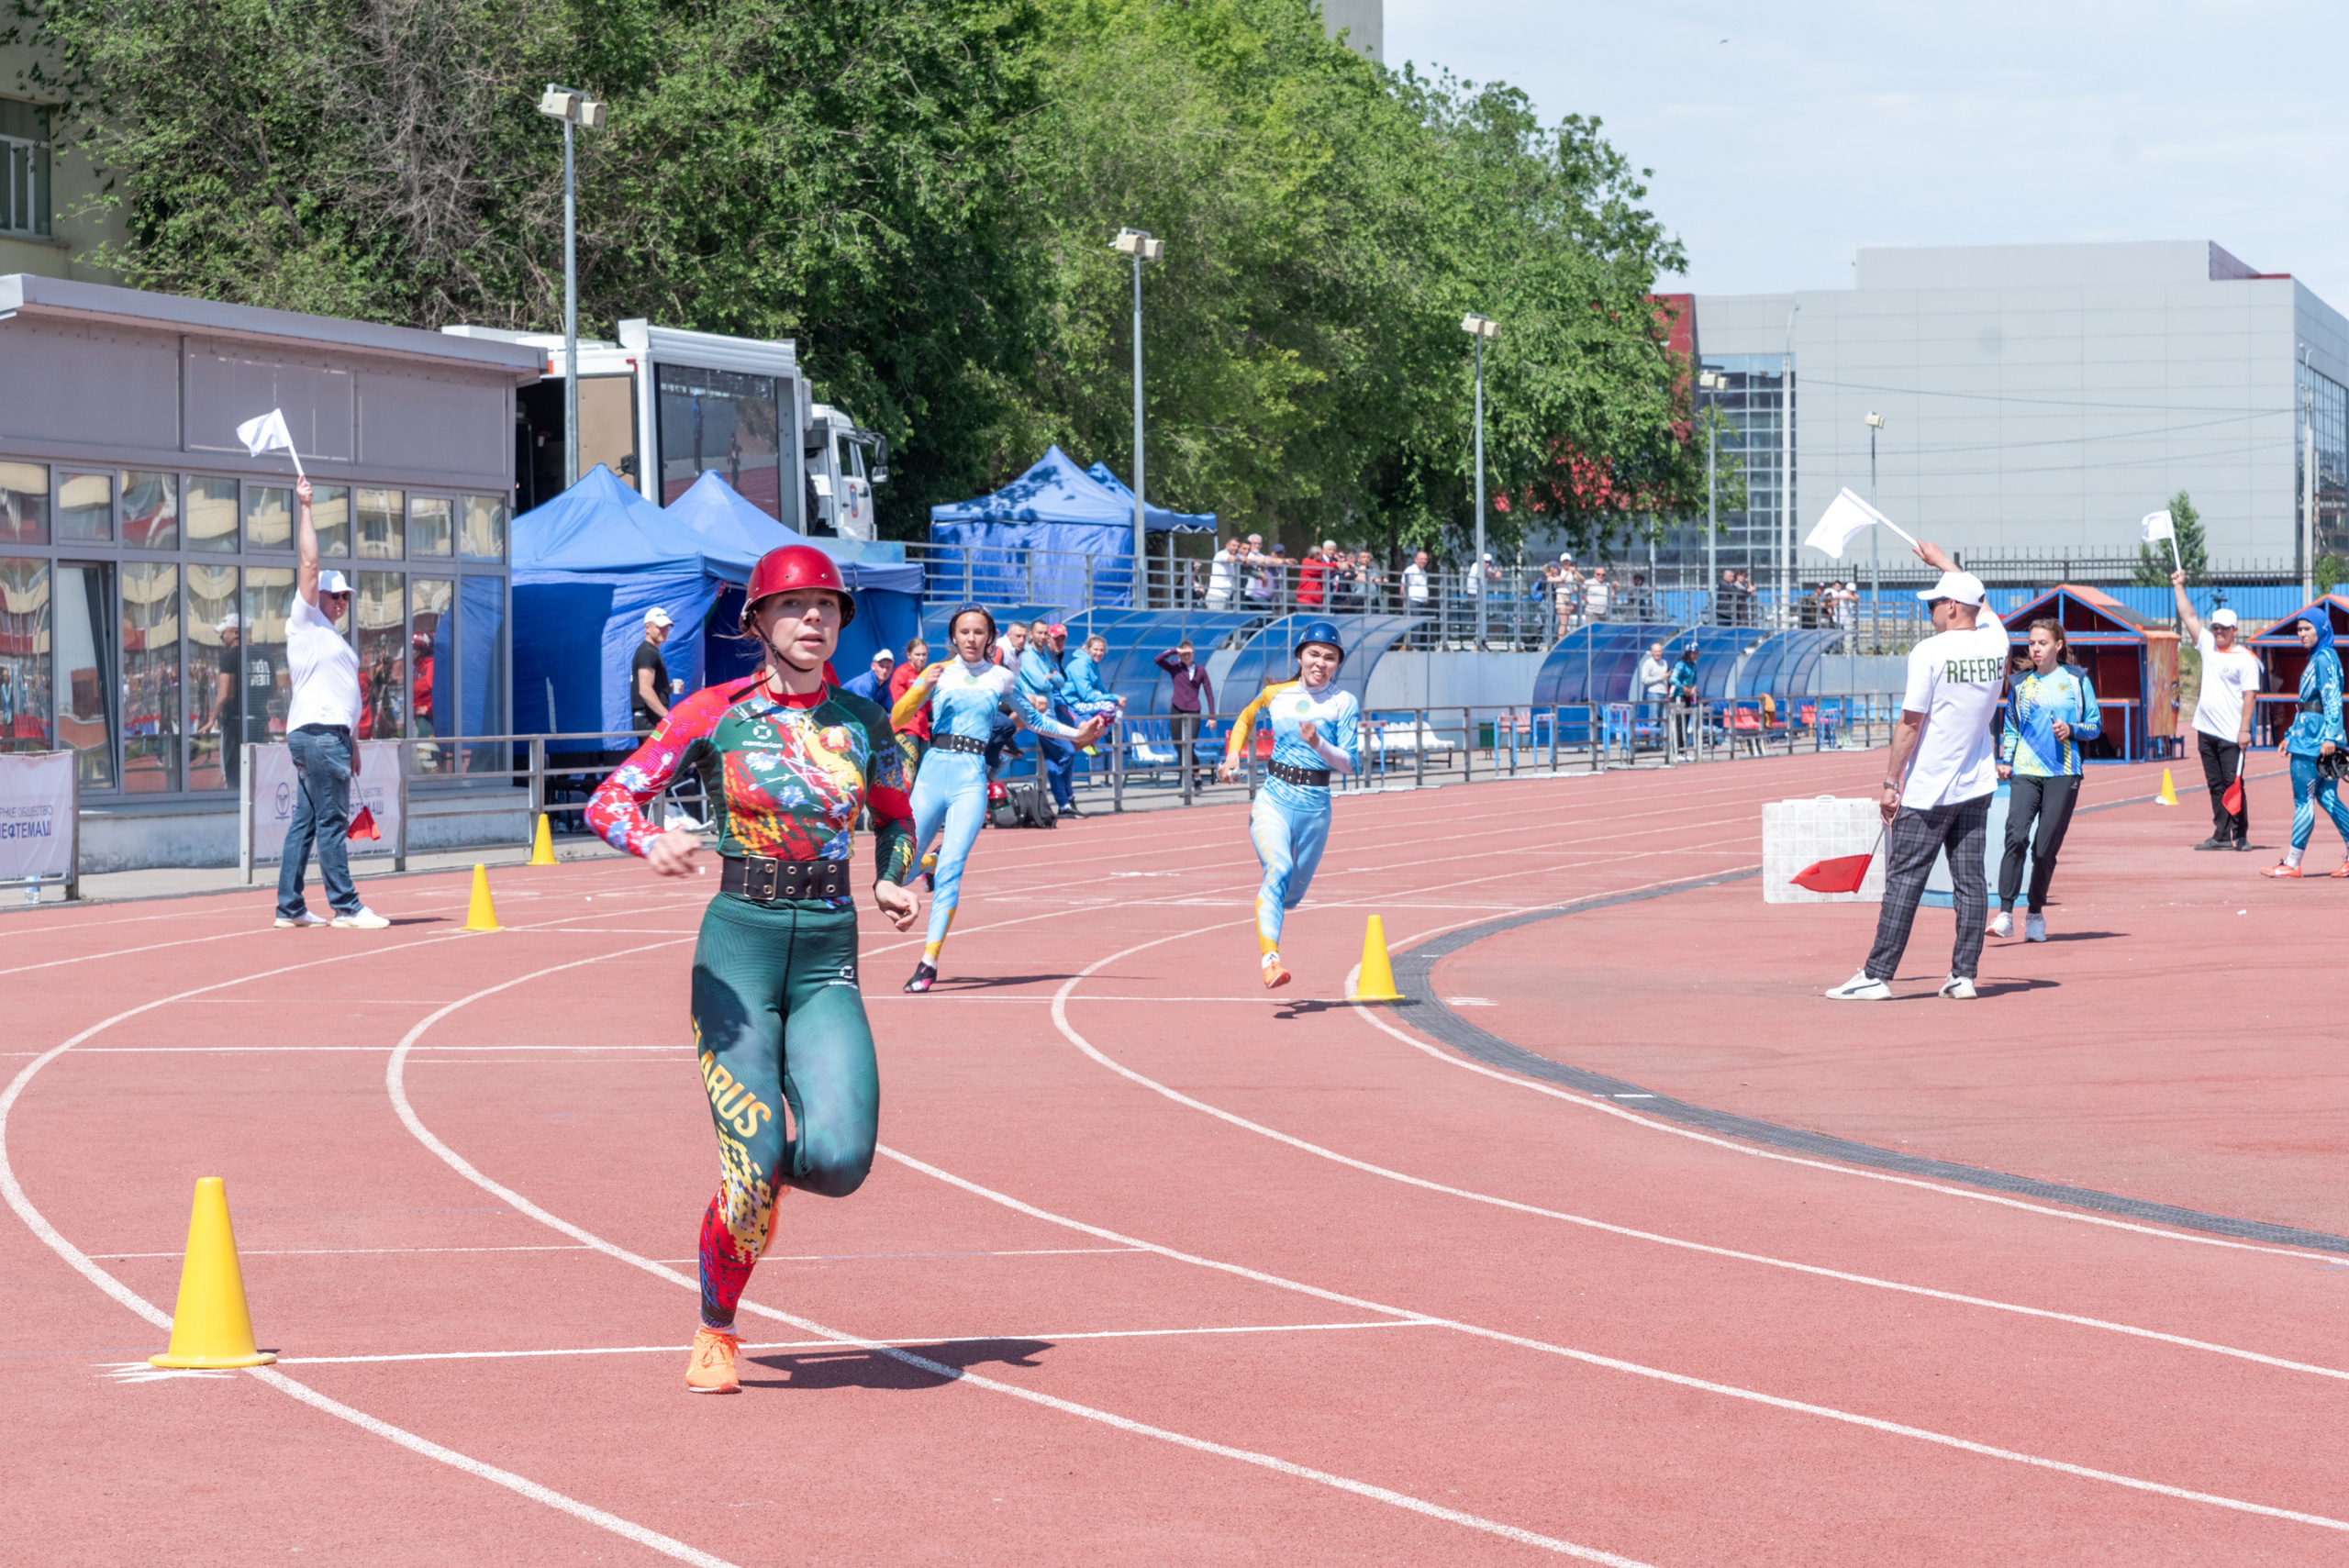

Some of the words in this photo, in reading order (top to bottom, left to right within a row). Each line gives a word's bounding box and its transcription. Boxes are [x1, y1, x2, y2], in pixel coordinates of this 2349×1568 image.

[1946, 656, 2008, 684] REFERE
[742, 740, 783, 749] centurion
[0, 820, 51, 839] ЕФТЕМАШ
[694, 1029, 772, 1139] ARUS
